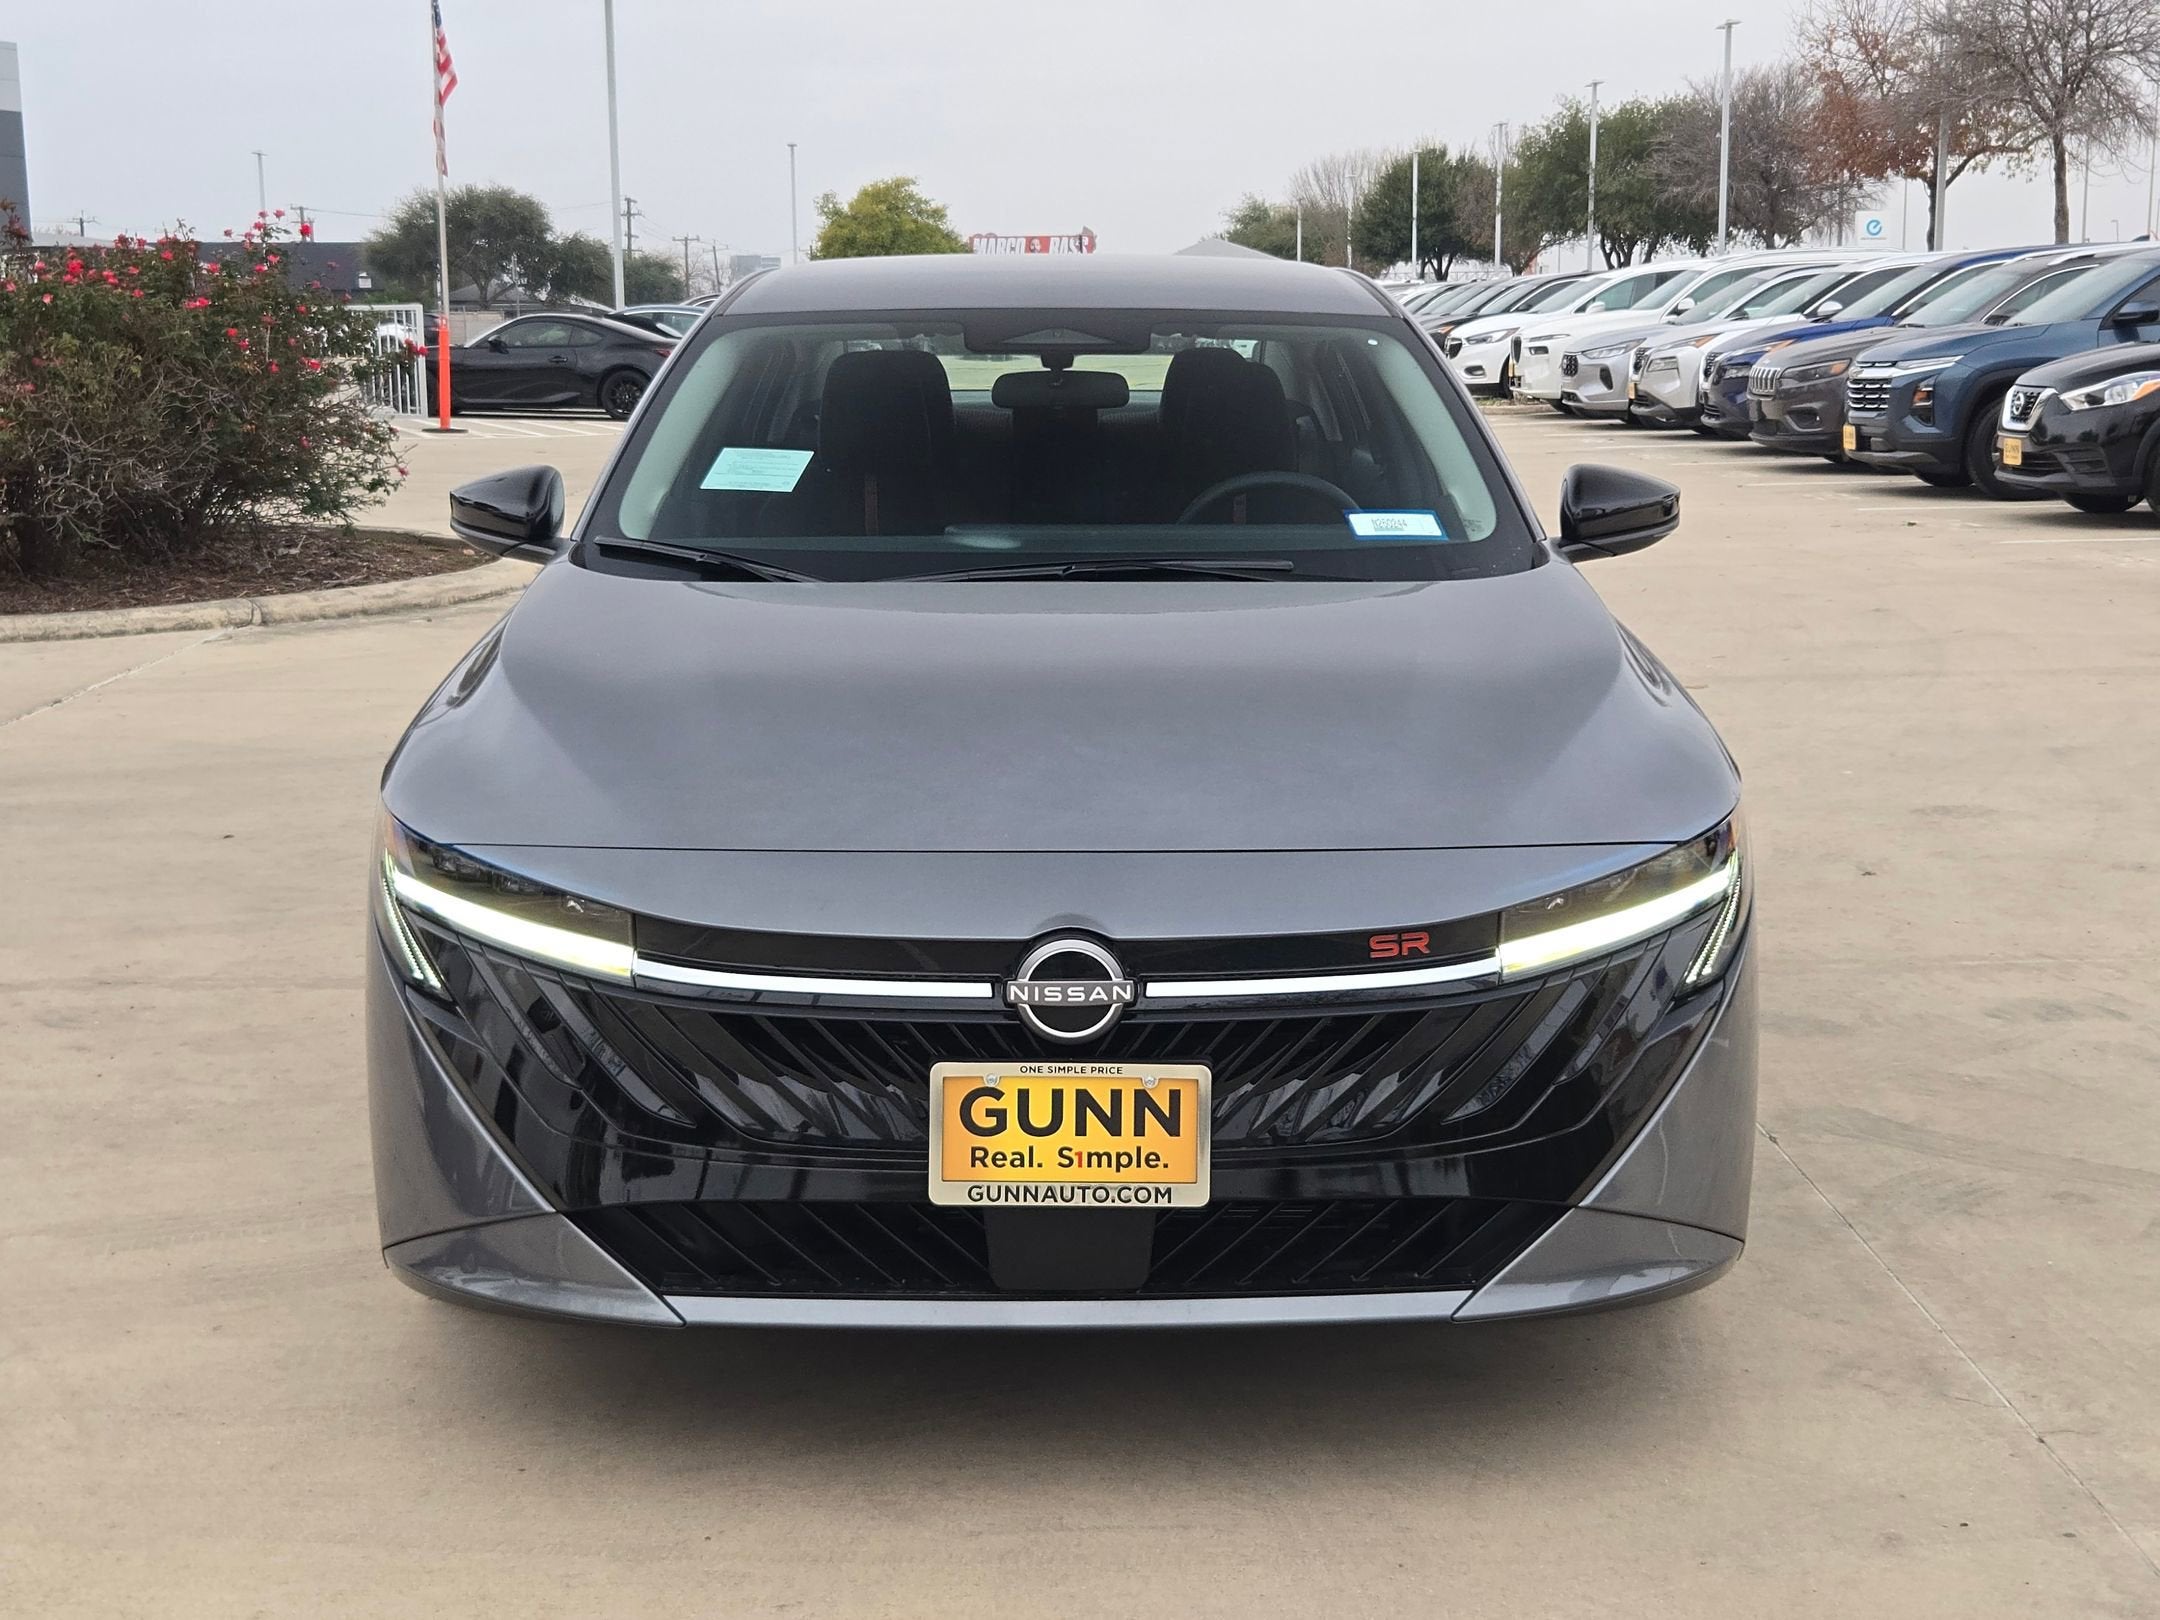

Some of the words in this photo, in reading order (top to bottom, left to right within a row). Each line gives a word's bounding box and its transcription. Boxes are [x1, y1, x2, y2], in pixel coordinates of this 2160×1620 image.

[1369, 931, 1431, 959] SR
[1010, 984, 1132, 1002] NISSAN
[1020, 1064, 1044, 1074] ONE
[1047, 1065, 1088, 1075] SIMPLE
[1090, 1066, 1123, 1075] PRICE
[959, 1086, 1182, 1138] GUNN
[970, 1145, 1043, 1169] Real.
[967, 1184, 1172, 1204] GUNNAUTO.COM
